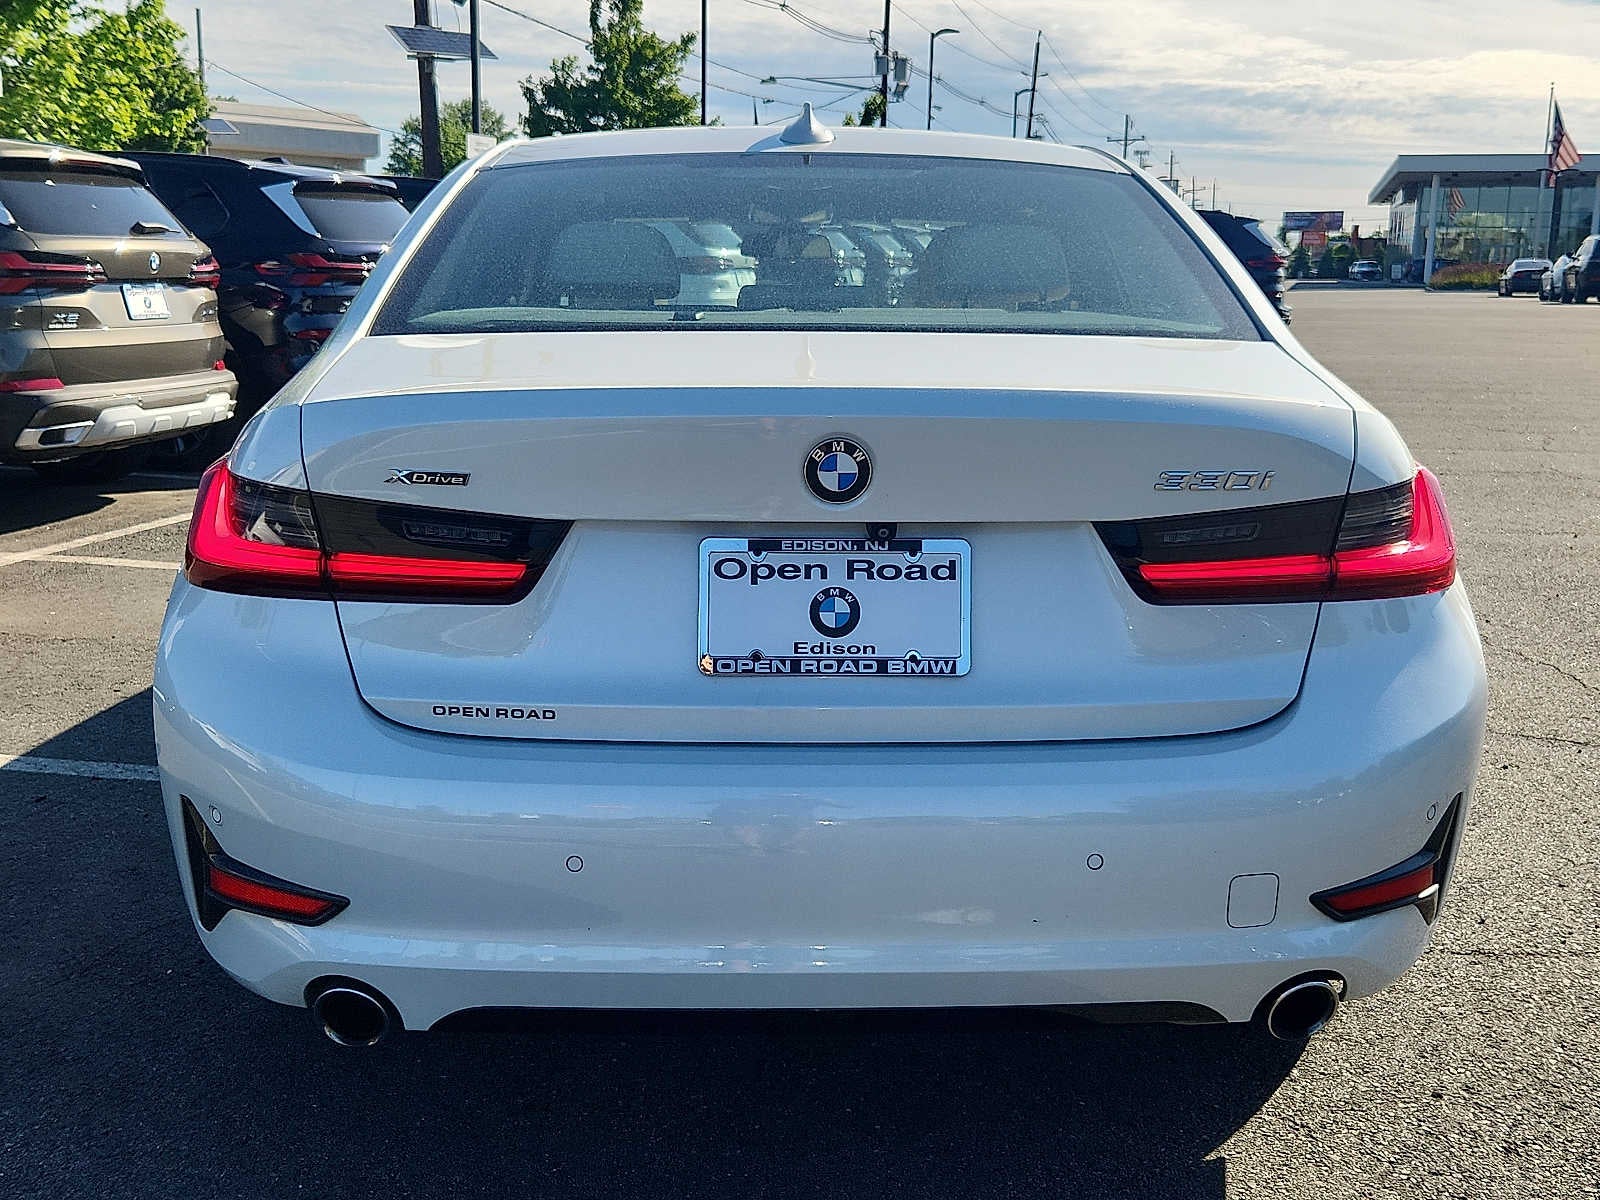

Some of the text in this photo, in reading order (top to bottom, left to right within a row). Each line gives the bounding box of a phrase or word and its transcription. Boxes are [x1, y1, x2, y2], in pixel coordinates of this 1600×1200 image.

[811, 441, 866, 462] BMW
[1154, 470, 1276, 490] 330i
[781, 540, 889, 551] EDISON, NJ
[713, 557, 957, 585] Open Road
[816, 588, 854, 602] BMW
[793, 641, 876, 655] Edison
[716, 660, 954, 673] OPEN ROAD BMW
[432, 705, 556, 720] OPEN ROAD
